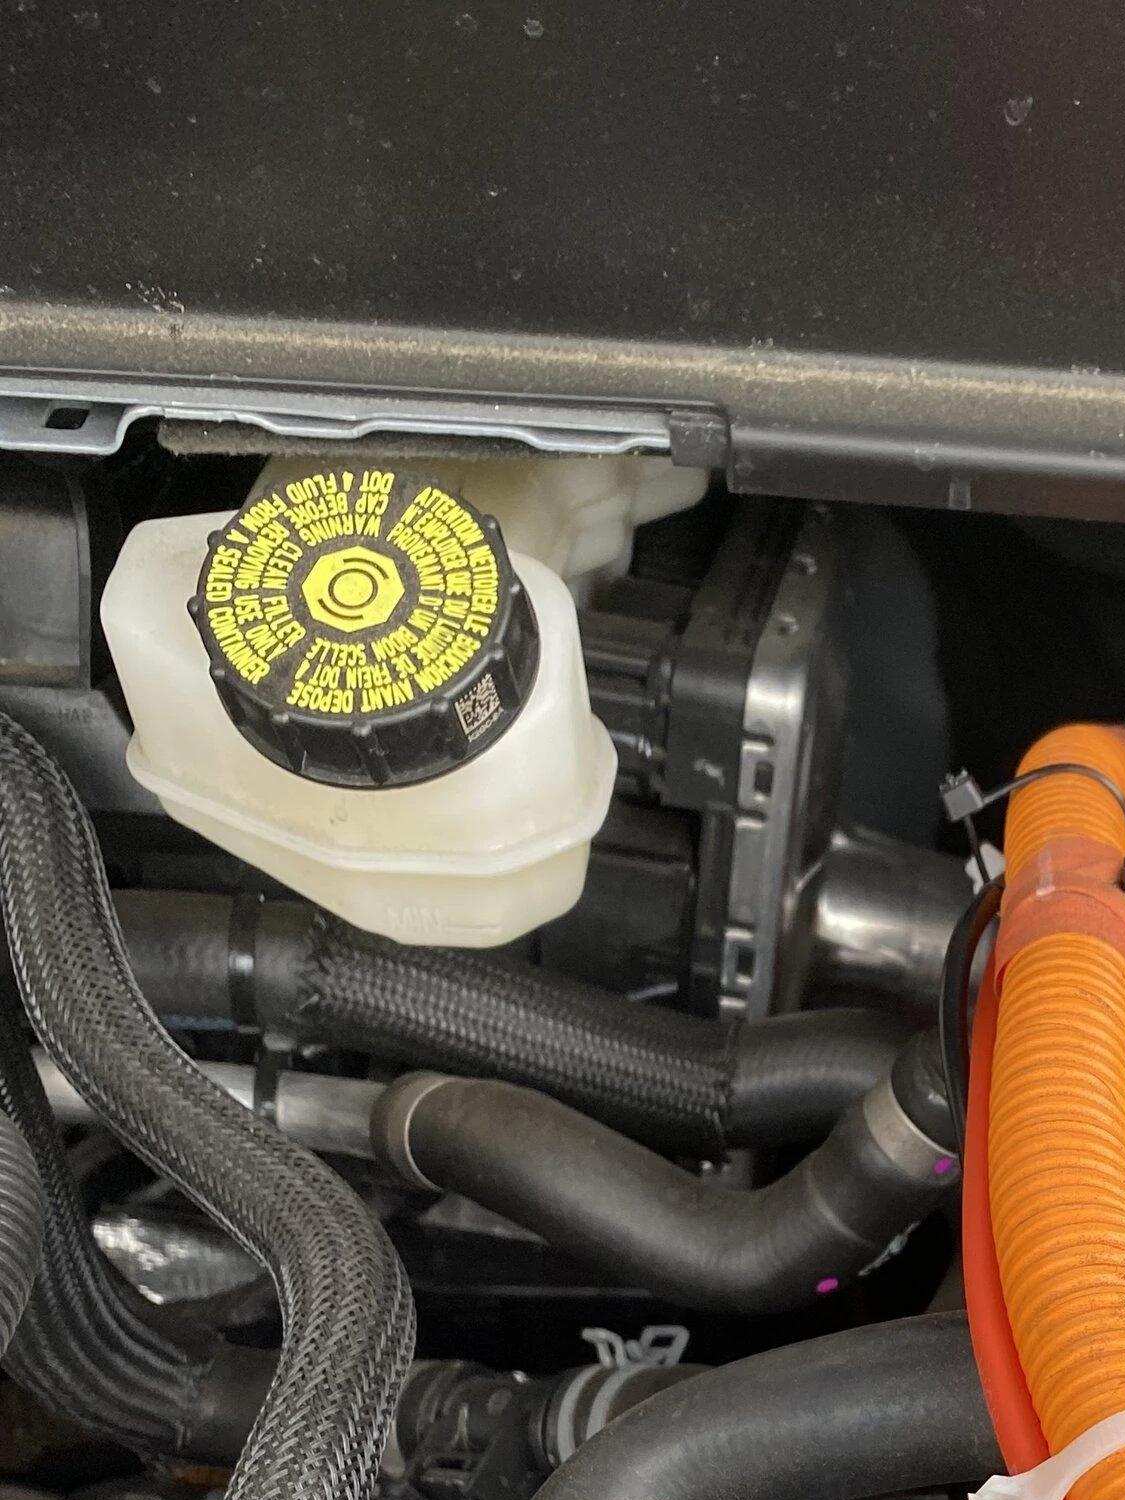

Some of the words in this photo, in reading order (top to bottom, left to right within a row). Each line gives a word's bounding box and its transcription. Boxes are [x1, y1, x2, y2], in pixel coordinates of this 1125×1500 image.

[286, 473, 337, 504] FLUID
[342, 471, 354, 492] 4
[359, 470, 395, 494] DOT
[239, 493, 288, 534] FROM
[283, 492, 348, 530] BEFORE
[354, 491, 389, 516] CAP
[413, 486, 485, 547] ATTENTION
[226, 528, 250, 545] A
[298, 513, 382, 547] WARNING
[234, 519, 290, 590] REMOVING
[262, 541, 303, 590] CLEAN
[386, 521, 446, 592] PROVENANT
[206, 545, 242, 602] SEALED
[444, 570, 473, 597] QUE
[467, 544, 499, 614] NETTOYER
[234, 594, 264, 626] USE
[262, 595, 306, 648] FILLER
[442, 598, 470, 620] DU
[463, 613, 492, 637] LE
[208, 605, 271, 685] CONTAINER
[245, 623, 287, 662] ONLY
[306, 637, 367, 667] SCELLE
[371, 625, 419, 662] BIDON
[410, 617, 461, 667] LIQUIDE
[295, 659, 311, 681] 4
[308, 664, 341, 689] DOT
[345, 661, 392, 690] FREIN
[391, 652, 417, 680] DE
[413, 633, 482, 693] BOUCHON
[286, 680, 354, 714] DEPOSE
[360, 677, 414, 713] AVANT
